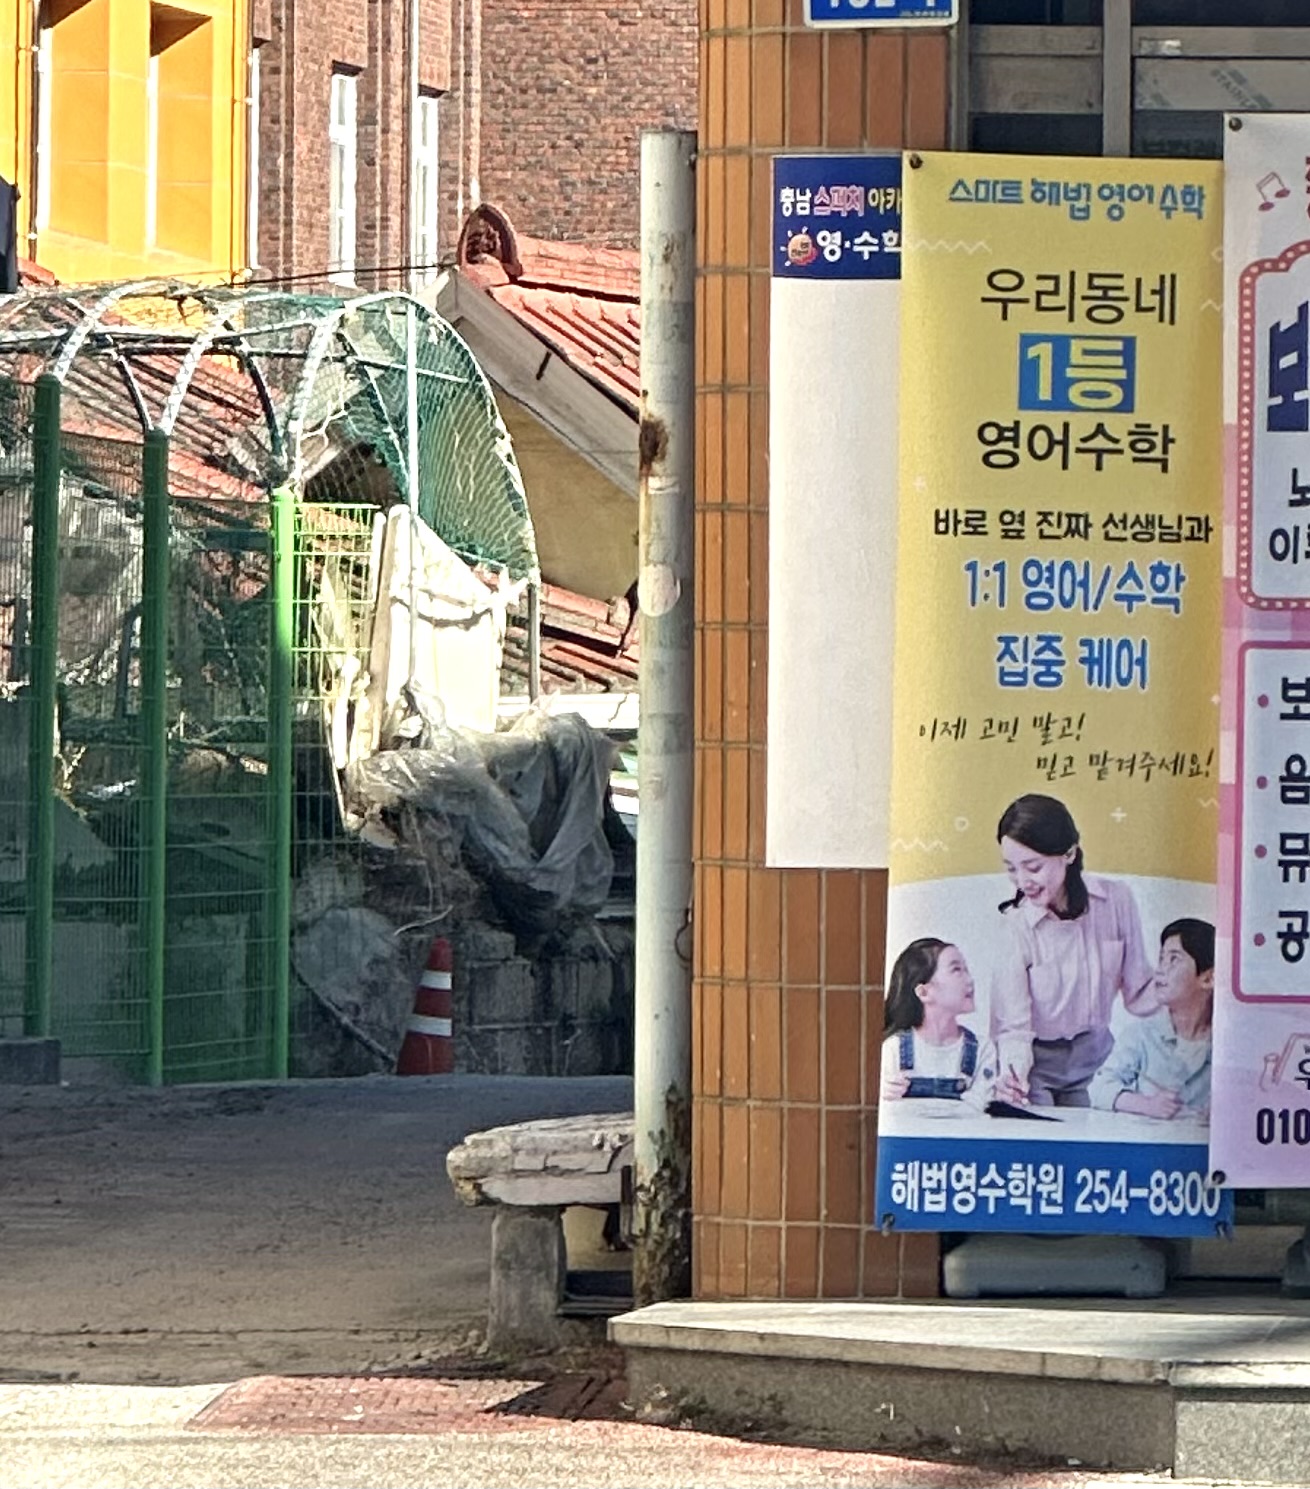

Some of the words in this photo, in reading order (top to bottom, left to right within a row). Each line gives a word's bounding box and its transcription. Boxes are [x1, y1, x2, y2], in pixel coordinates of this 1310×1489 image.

[948, 178, 1025, 205] 스마트
[1031, 178, 1092, 221] 해법
[1097, 182, 1154, 221] 영어
[1159, 184, 1206, 220] 수학
[981, 269, 1177, 325] 우리동네
[1025, 339, 1127, 409] 1등
[977, 420, 1176, 474] 영어수학
[934, 508, 989, 537] 바로
[999, 509, 1026, 540] 옆
[1036, 510, 1093, 541] 진짜
[1102, 512, 1214, 543] 선생님과
[964, 560, 1007, 608] 1:1
[1022, 559, 1187, 614] 영어/수학
[996, 633, 1066, 688] 집중
[1078, 637, 1148, 690] 케어
[919, 716, 967, 743] 이제
[979, 716, 1019, 743] 고민
[1032, 712, 1086, 746] 말고!
[1036, 752, 1076, 782] 믿고
[1088, 748, 1215, 784] 맡겨주세요!
[891, 1160, 1065, 1216] 해법영수학원
[1075, 1168, 1222, 1218] 254-8300
